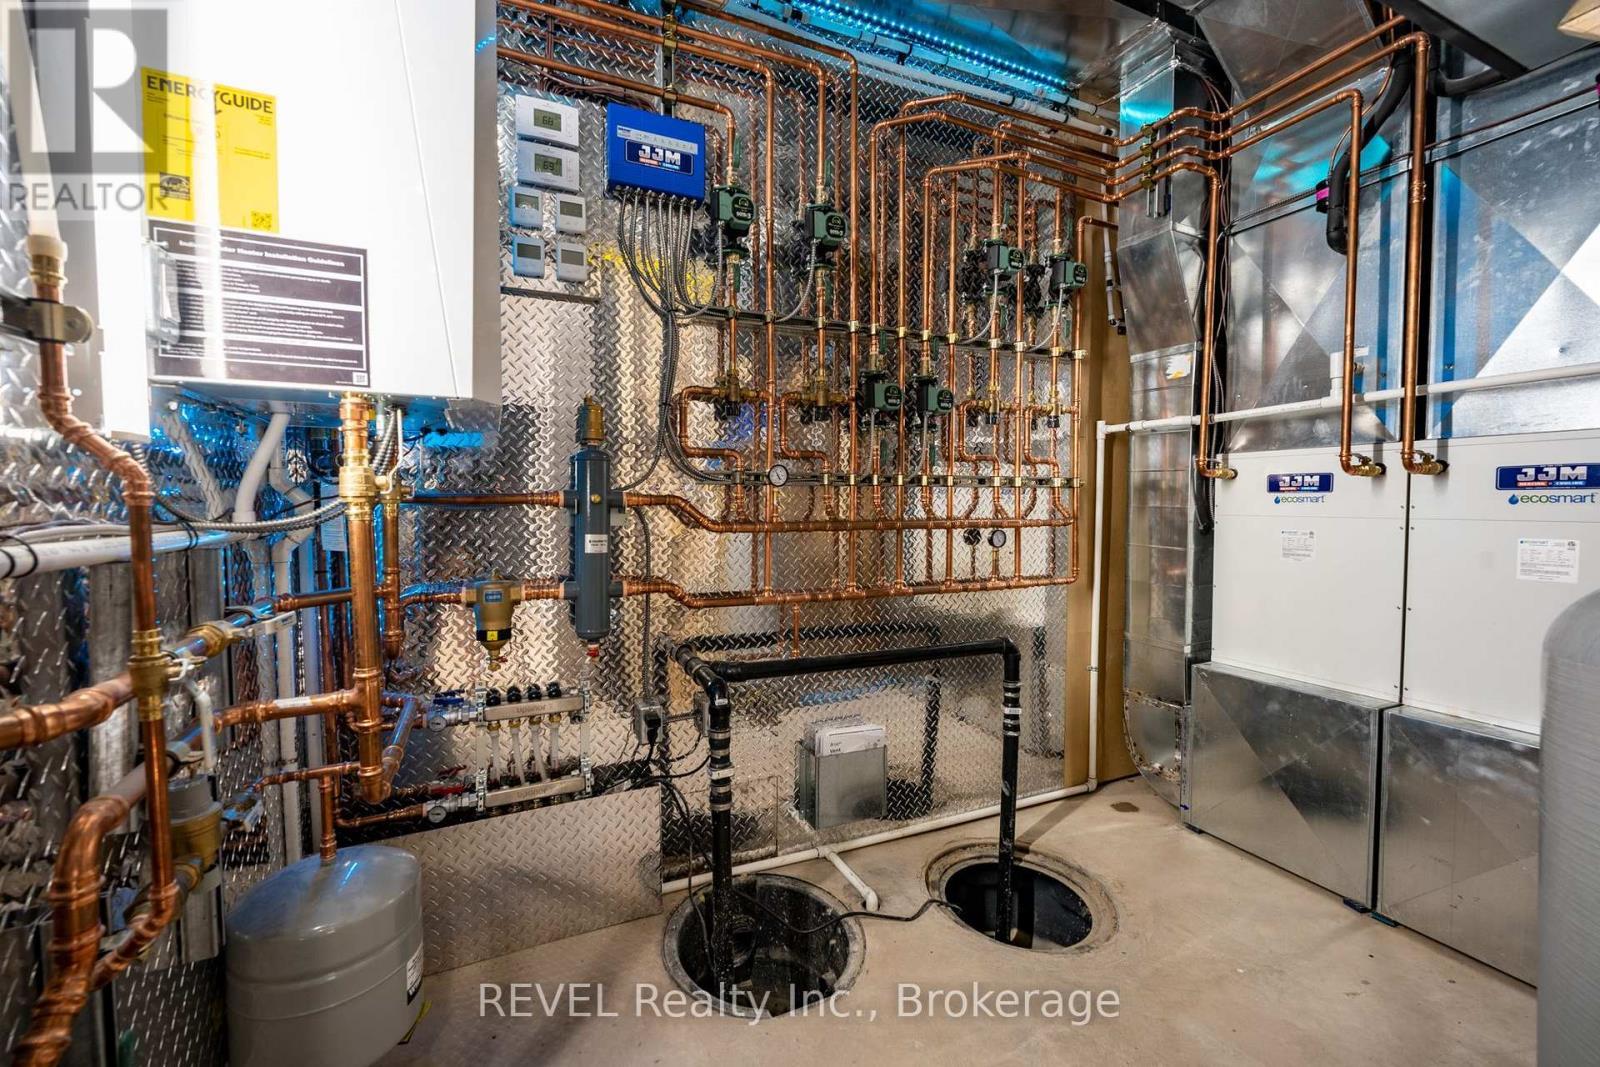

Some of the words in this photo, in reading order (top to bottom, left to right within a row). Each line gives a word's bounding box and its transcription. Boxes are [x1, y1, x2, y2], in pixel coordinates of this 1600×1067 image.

[638, 144, 681, 166] JJM
[1517, 465, 1588, 481] JJM
[1278, 475, 1320, 487] JJM
[1280, 495, 1325, 504] ecosmart
[1520, 493, 1596, 504] ecosmart
